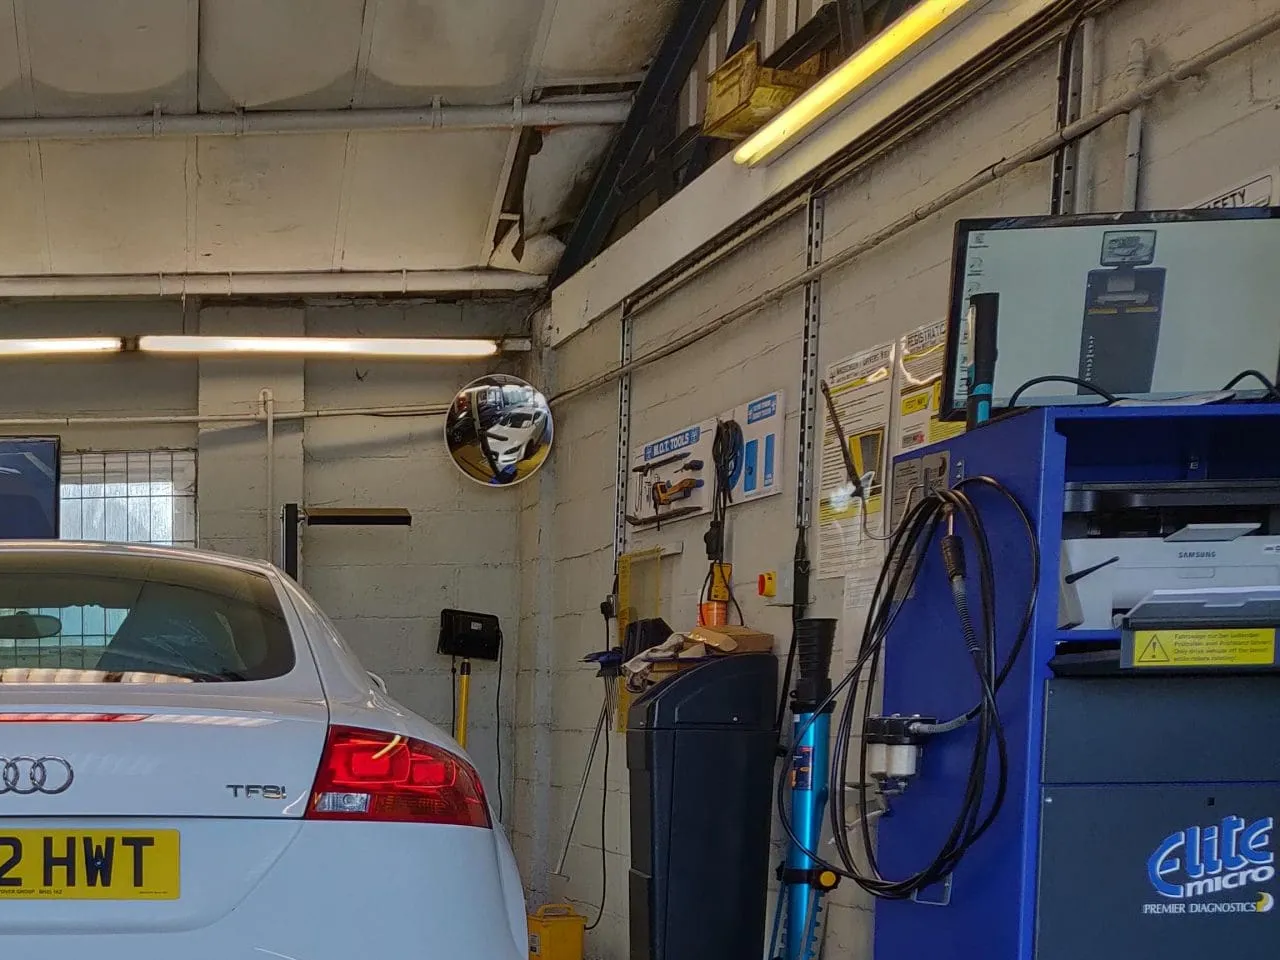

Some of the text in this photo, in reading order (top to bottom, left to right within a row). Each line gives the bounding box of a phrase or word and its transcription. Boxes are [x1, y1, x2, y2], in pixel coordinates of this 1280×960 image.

[670, 432, 690, 449] TOOLS
[1177, 551, 1217, 559] SAMSUNG
[226, 784, 287, 800] TFSI
[42, 836, 155, 887] HWT
[1146, 814, 1274, 899] Elite
[1185, 865, 1276, 898] micro
[1143, 902, 1257, 914] PREMIER DIAGNOSTICS
